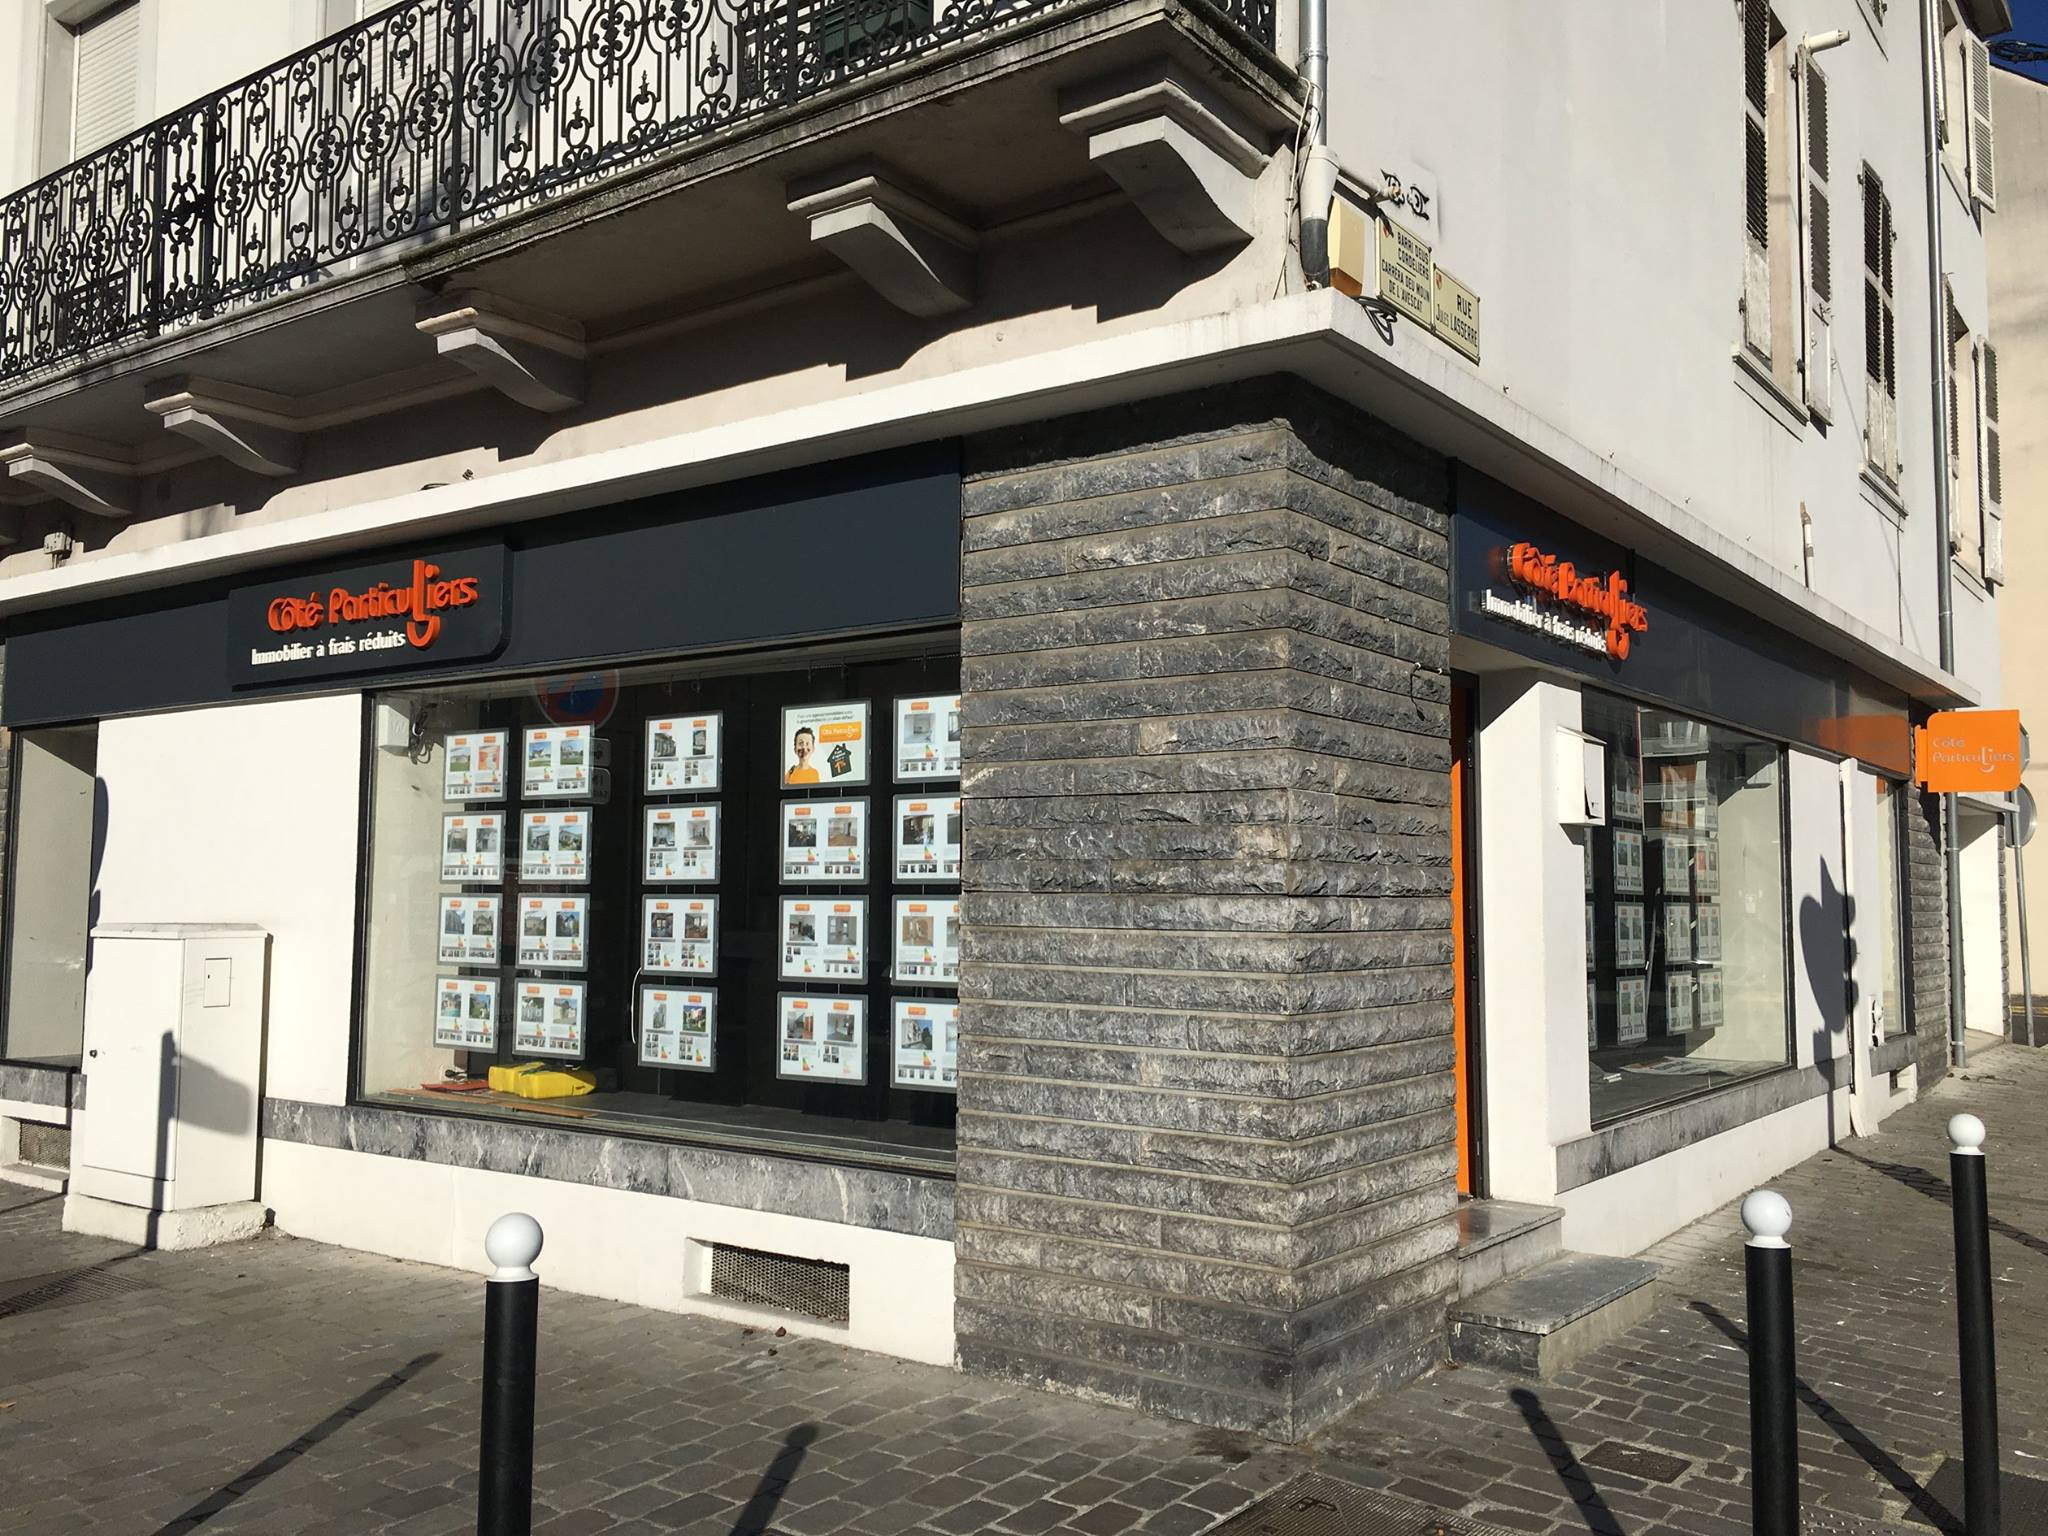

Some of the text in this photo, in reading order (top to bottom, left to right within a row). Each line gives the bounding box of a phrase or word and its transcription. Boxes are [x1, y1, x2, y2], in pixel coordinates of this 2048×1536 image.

[1397, 231, 1429, 266] BARRI DEUS
[1398, 247, 1429, 280] CORDELIERS
[1389, 279, 1396, 296] DE
[1405, 275, 1416, 292] DEU
[1456, 294, 1472, 320] RUE
[1450, 312, 1478, 347] LASSERRE
[268, 591, 324, 632] Côté
[1486, 588, 1608, 652] Immobilier à frais réduits
[251, 630, 406, 665] Immobilier à frais réduits
